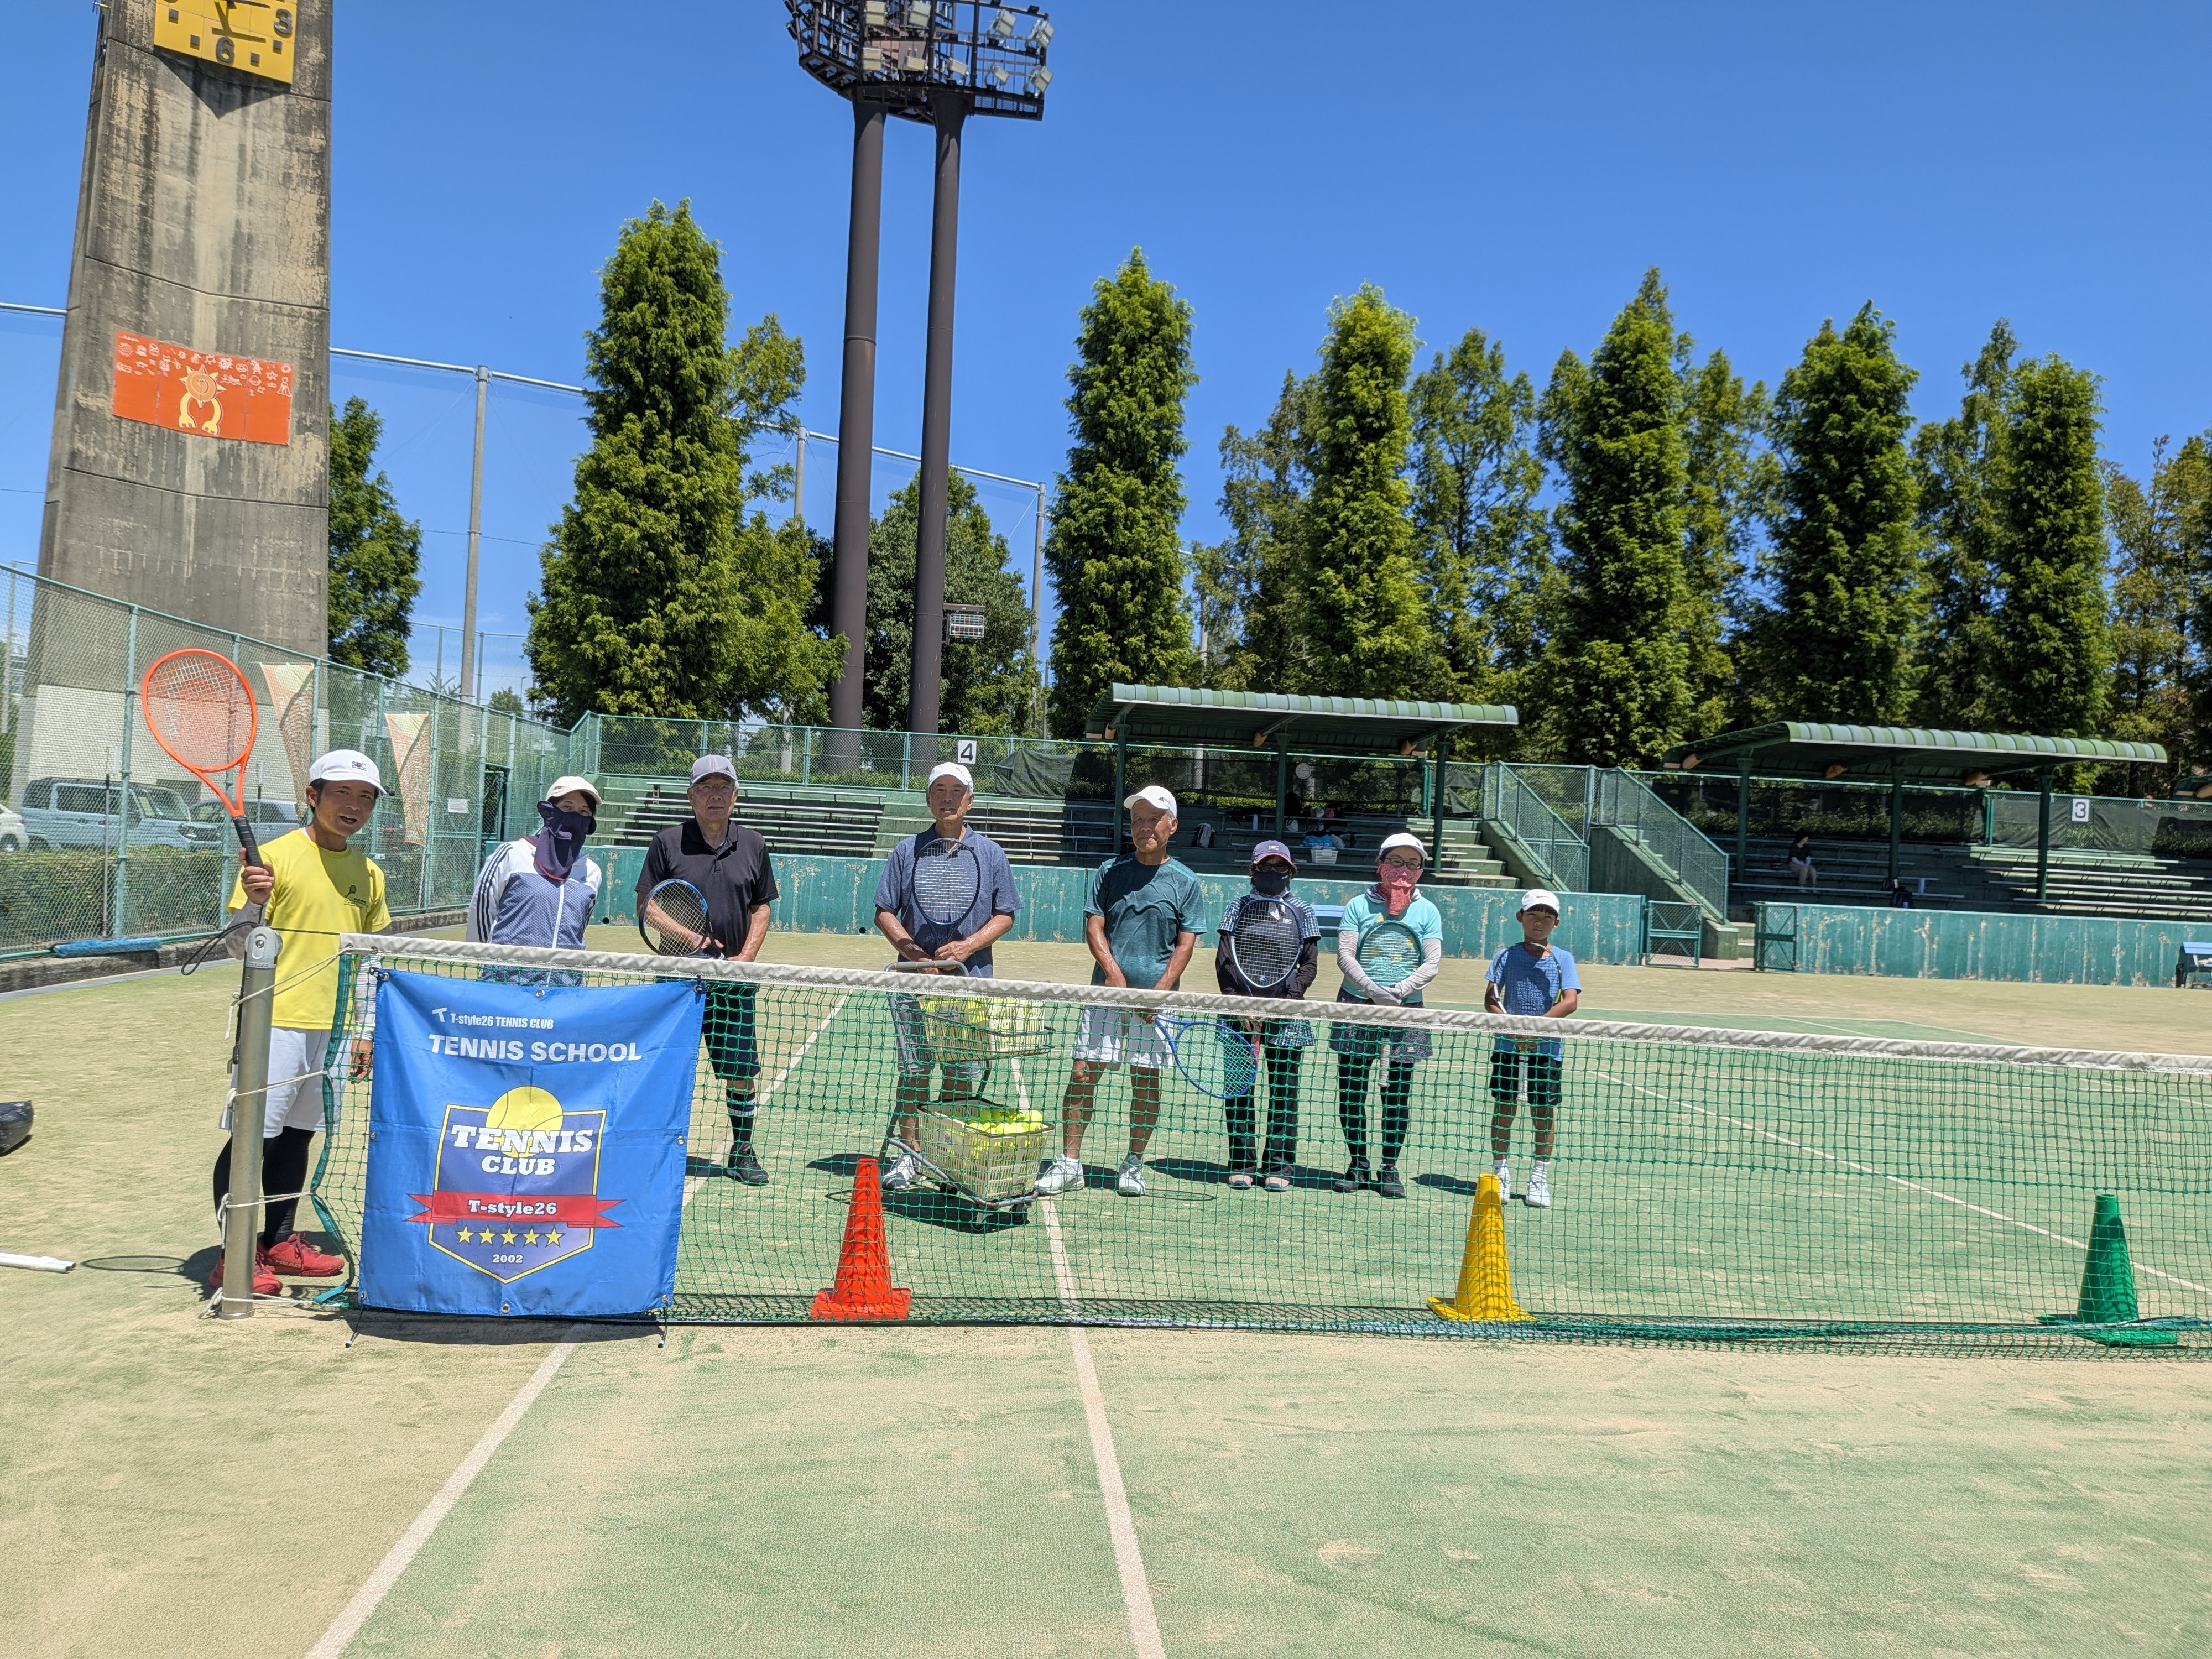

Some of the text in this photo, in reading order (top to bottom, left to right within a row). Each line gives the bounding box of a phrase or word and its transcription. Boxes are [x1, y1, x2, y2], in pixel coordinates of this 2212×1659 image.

[274, 9, 293, 34] 3
[216, 36, 235, 63] 6
[961, 743, 973, 761] 4
[2075, 802, 2086, 818] 3
[450, 1013, 494, 1027] T-style26
[495, 1016, 528, 1029] TENNIS
[529, 1018, 554, 1030] CLUB
[429, 1034, 643, 1062] TENNIS SCHOOL
[451, 1124, 594, 1154] TENNIS
[481, 1155, 556, 1176] CLUB
[468, 1199, 557, 1218] T-style26
[276, 1260, 301, 1269] HEAD
[492, 1254, 523, 1264] 2002
